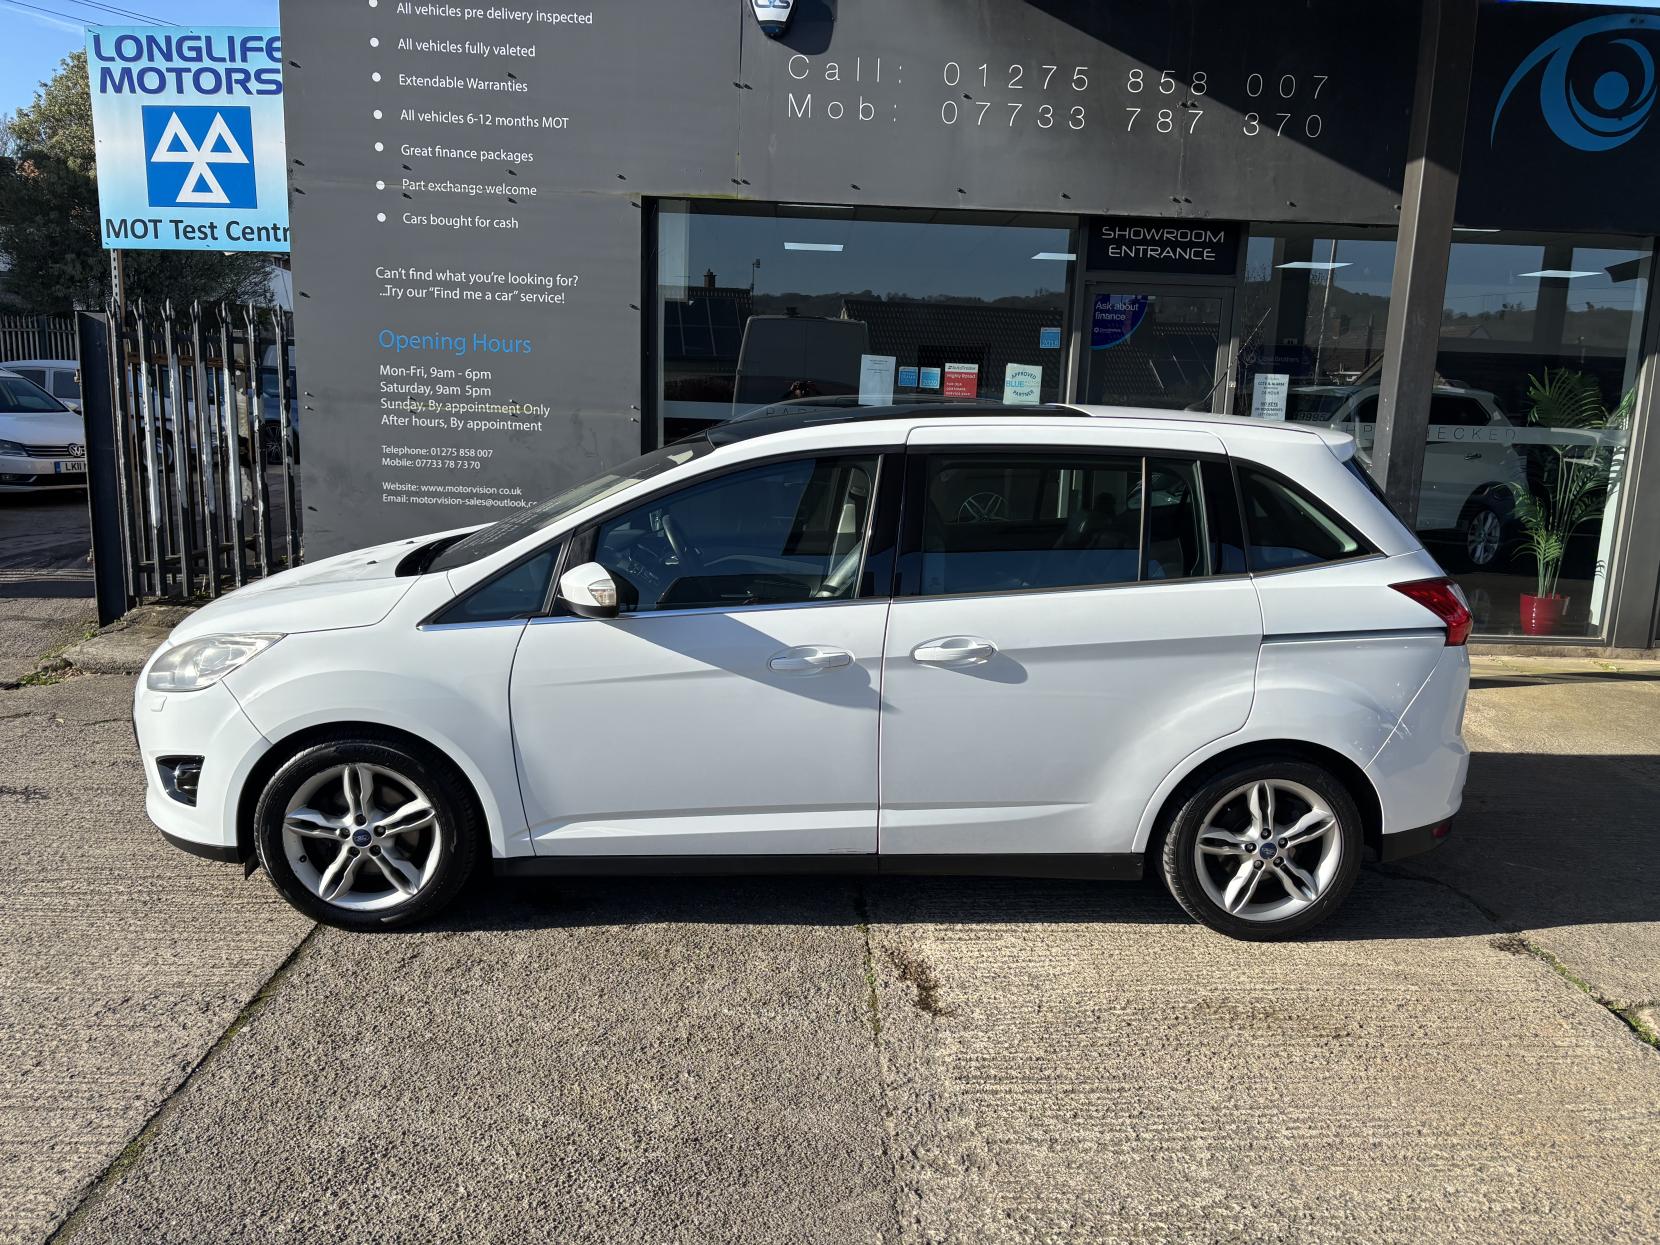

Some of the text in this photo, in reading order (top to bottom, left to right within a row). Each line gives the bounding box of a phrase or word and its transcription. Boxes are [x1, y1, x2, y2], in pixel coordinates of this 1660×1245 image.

[396, 2, 593, 25] All vehicles pre delivery inspected
[397, 38, 536, 58] All vehicles fully valeted
[100, 67, 283, 95] MOTORS
[398, 74, 528, 92] Extendable Warranties
[943, 62, 1089, 90] 01275
[1127, 69, 1208, 95] 858
[1246, 73, 1329, 99] 007
[400, 110, 570, 129] All vehicles 6-12 months MOT
[941, 101, 1085, 129] 07733
[1125, 104, 1204, 134] 787
[1242, 113, 1322, 137] 370
[400, 145, 534, 164] Great finance packages
[402, 179, 537, 196] Part exchange welcome
[402, 213, 519, 229] Cars bought for cash
[105, 218, 290, 242] MOT Test Centr
[1101, 227, 1225, 242] SHOWROOM
[1108, 245, 1216, 260] ENTRANCE
[375, 267, 579, 289] Can't find what you're looking for?
[406, 289, 428, 298] our
[428, 287, 460, 299] "Find
[463, 291, 483, 300] me
[484, 292, 492, 301] a
[494, 291, 519, 301] car"
[520, 292, 565, 304] service!
[1095, 302, 1139, 311] Ask about
[1095, 311, 1126, 321] finance
[378, 330, 532, 356] Opening Hours
[379, 365, 428, 379] Mon-Fri,
[429, 367, 455, 378] 9am
[465, 369, 492, 382] 6pm
[1011, 371, 1036, 380] APPROVED
[380, 382, 492, 398] Saturday, 9am 5pm
[1006, 380, 1024, 388] BLUE
[380, 397, 551, 418] Sunday, By appointment Only
[381, 415, 543, 432] After hours, By appointment
[381, 446, 494, 458] Telephone: 01275 858 007
[381, 458, 414, 467] Mobile:
[415, 459, 442, 468] 07733
[382, 482, 419, 492] Website:
[382, 494, 409, 504] Email:
